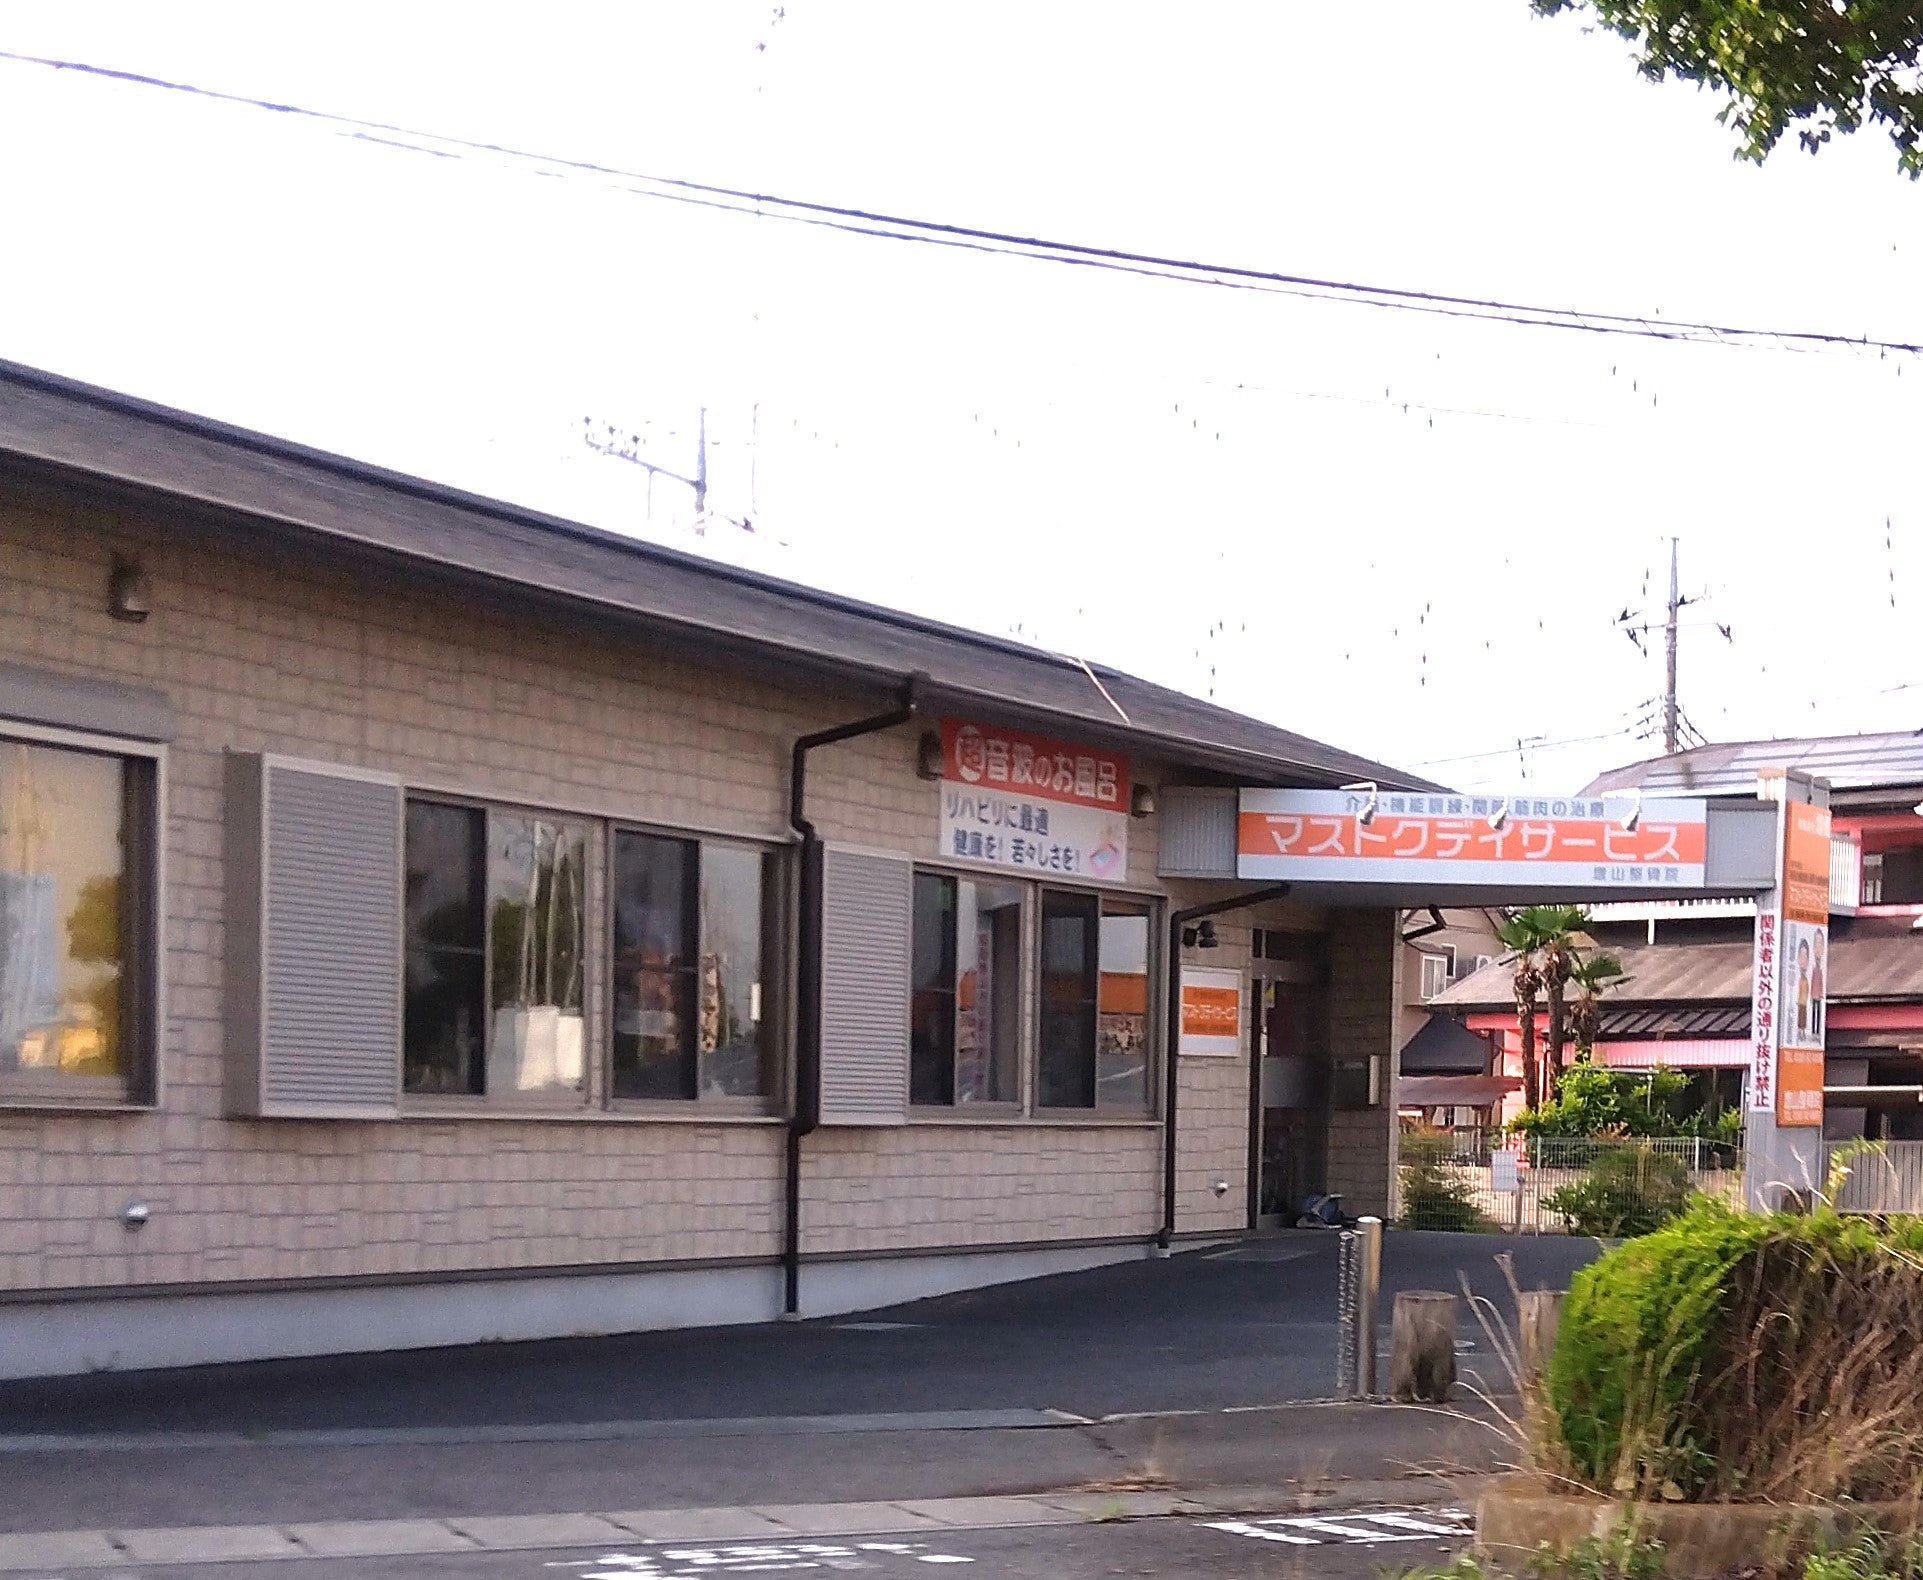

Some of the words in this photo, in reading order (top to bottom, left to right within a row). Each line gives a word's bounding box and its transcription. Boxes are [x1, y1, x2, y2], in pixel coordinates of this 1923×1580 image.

[946, 791, 1050, 837] リハビリに最適
[1753, 913, 1775, 1108] 関係者以外の通り抜け禁止
